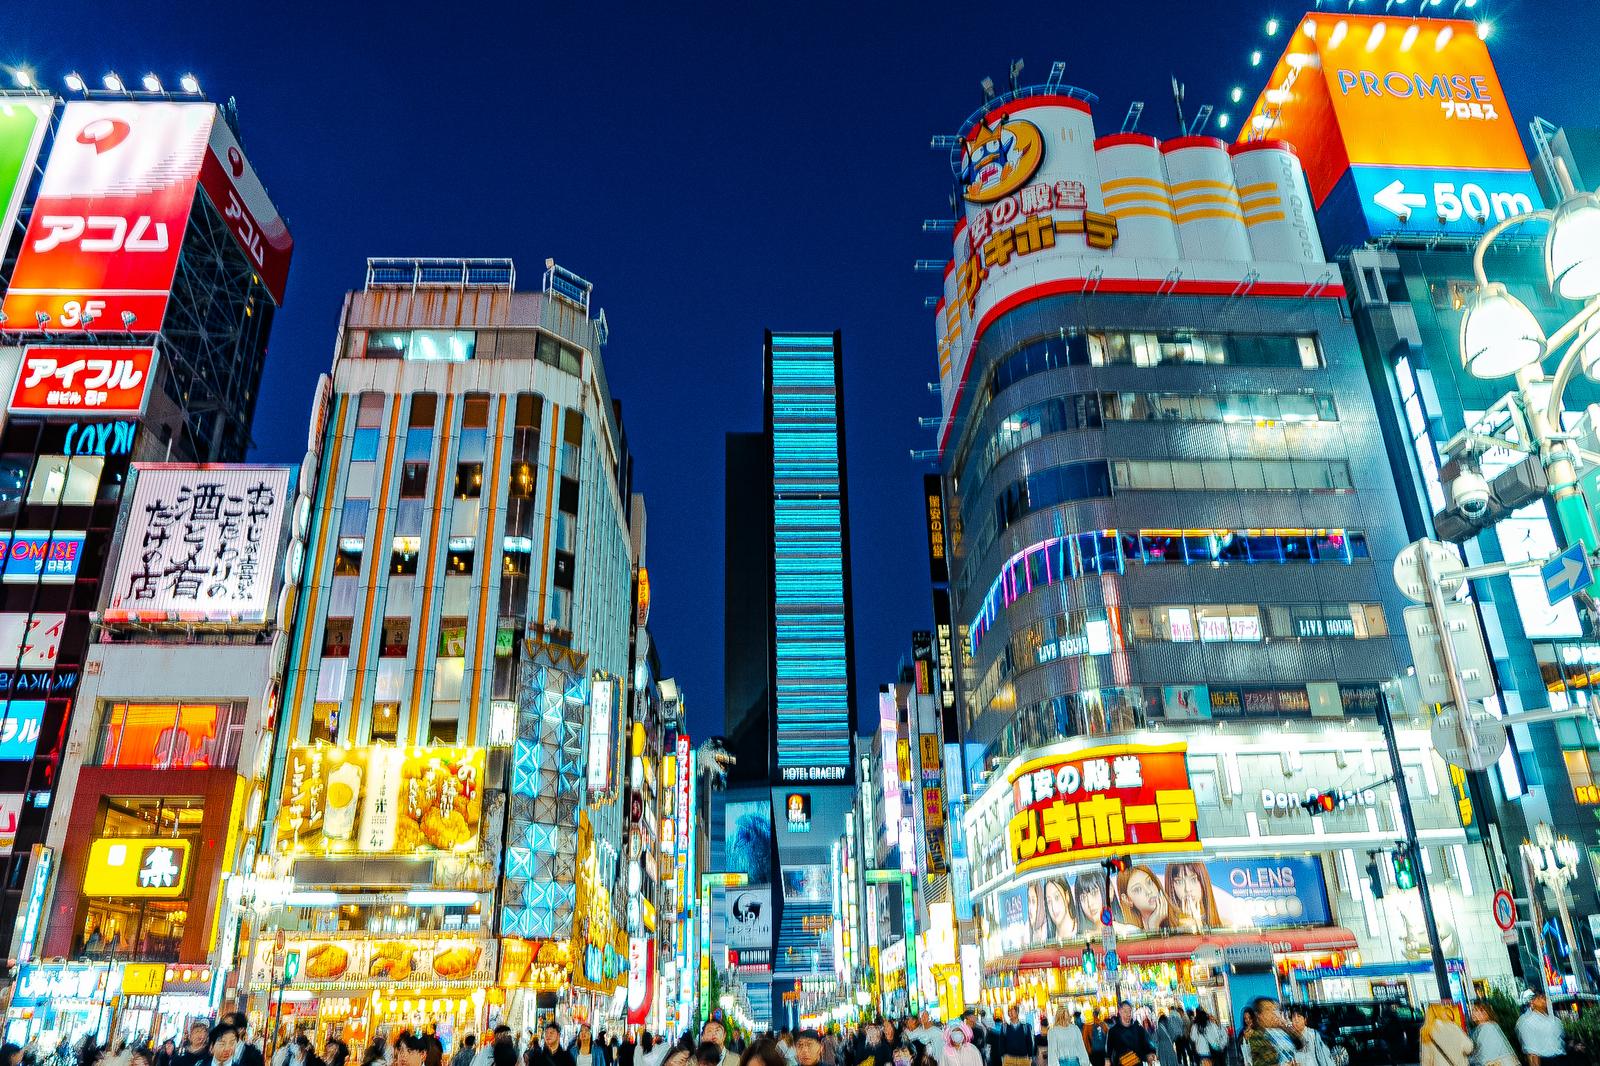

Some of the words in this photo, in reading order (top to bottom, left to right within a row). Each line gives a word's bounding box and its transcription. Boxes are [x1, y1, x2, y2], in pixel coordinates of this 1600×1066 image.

[1337, 70, 1492, 102] PROMISE
[1440, 100, 1499, 121] プロミス
[1434, 182, 1533, 223] 50m
[34, 215, 169, 253] アコム
[225, 189, 264, 268] アコム
[60, 301, 106, 328] 3F
[24, 358, 143, 390] アイフル
[1299, 619, 1324, 637] LIVE
[1325, 619, 1354, 637] HOUSE
[782, 766, 808, 781] HOTEL
[809, 766, 846, 780] GRACERY
[1261, 788, 1300, 810] Don
[1230, 866, 1295, 888] OLENS
